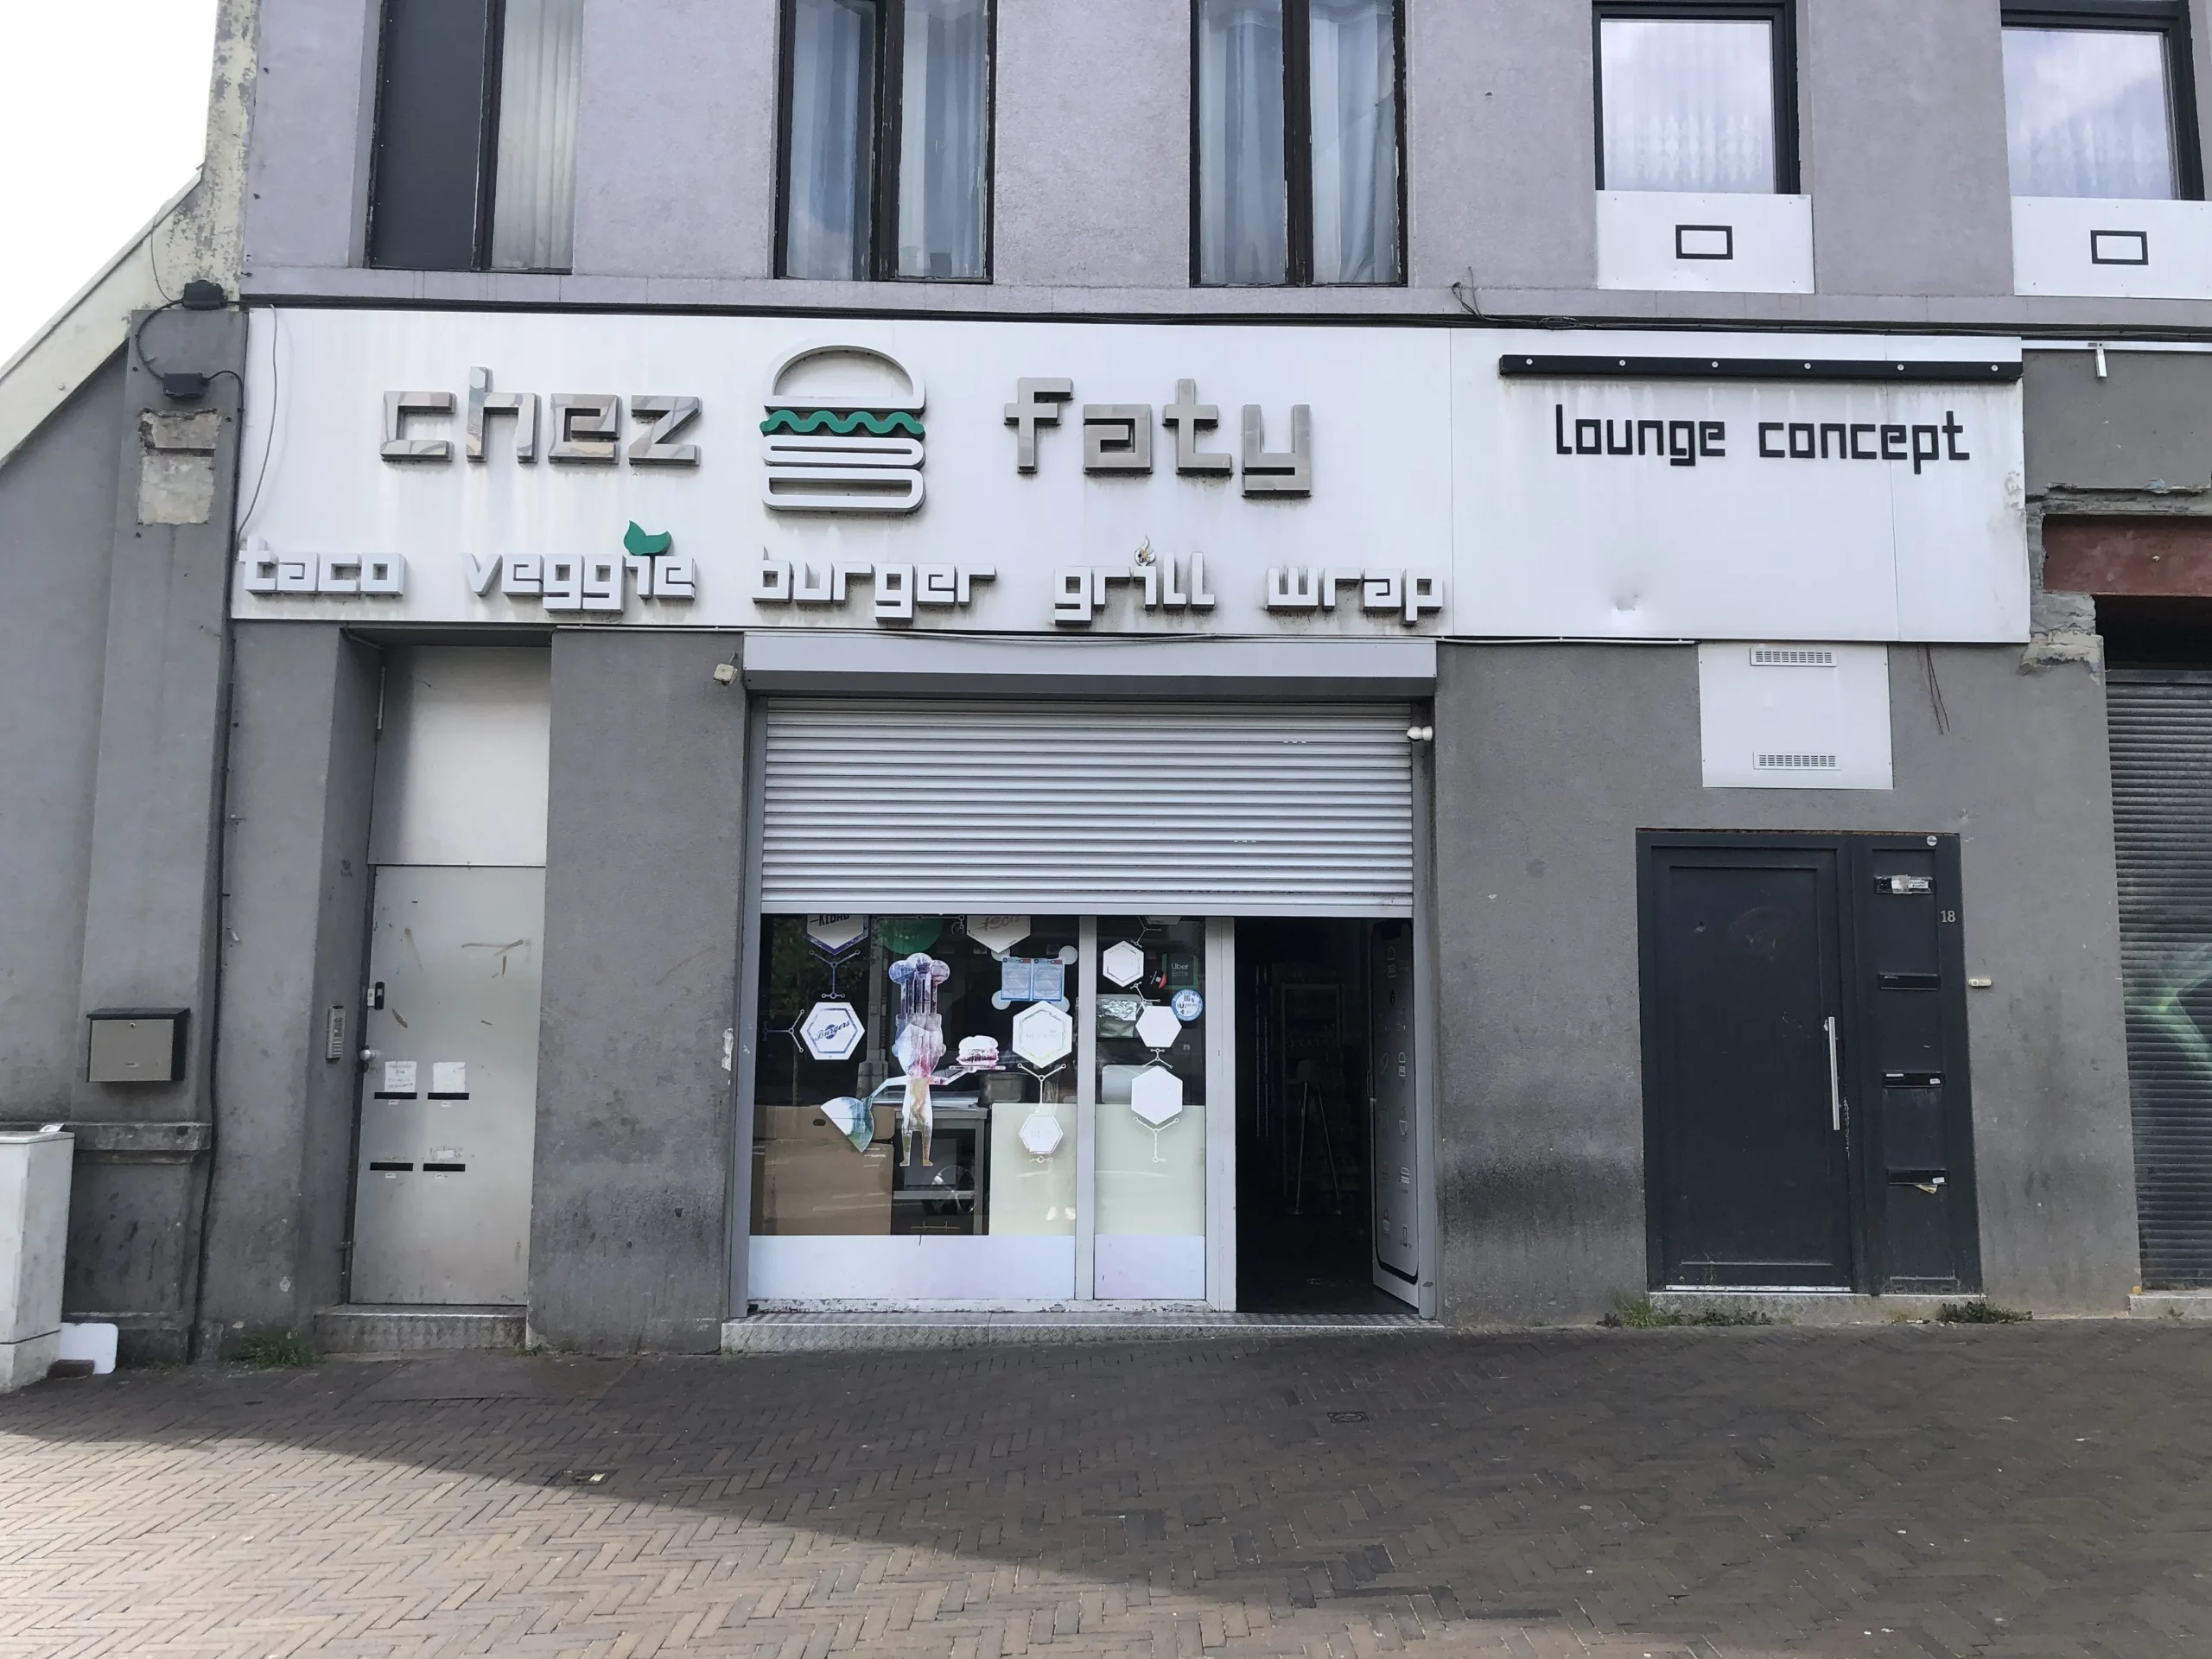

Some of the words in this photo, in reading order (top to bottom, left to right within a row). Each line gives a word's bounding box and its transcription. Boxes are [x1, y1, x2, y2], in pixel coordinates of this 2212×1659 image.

[380, 365, 702, 466] chez
[1003, 377, 1312, 499] faty
[1555, 404, 1726, 467] lounge
[1758, 410, 1971, 475] concept
[238, 534, 405, 595] taco
[461, 522, 696, 614] veggie
[752, 544, 997, 624] burger
[1053, 537, 1216, 626] grill
[1266, 566, 1444, 626] wrap
[1940, 910, 1957, 923] 18
[814, 1020, 851, 1042] Burgers
